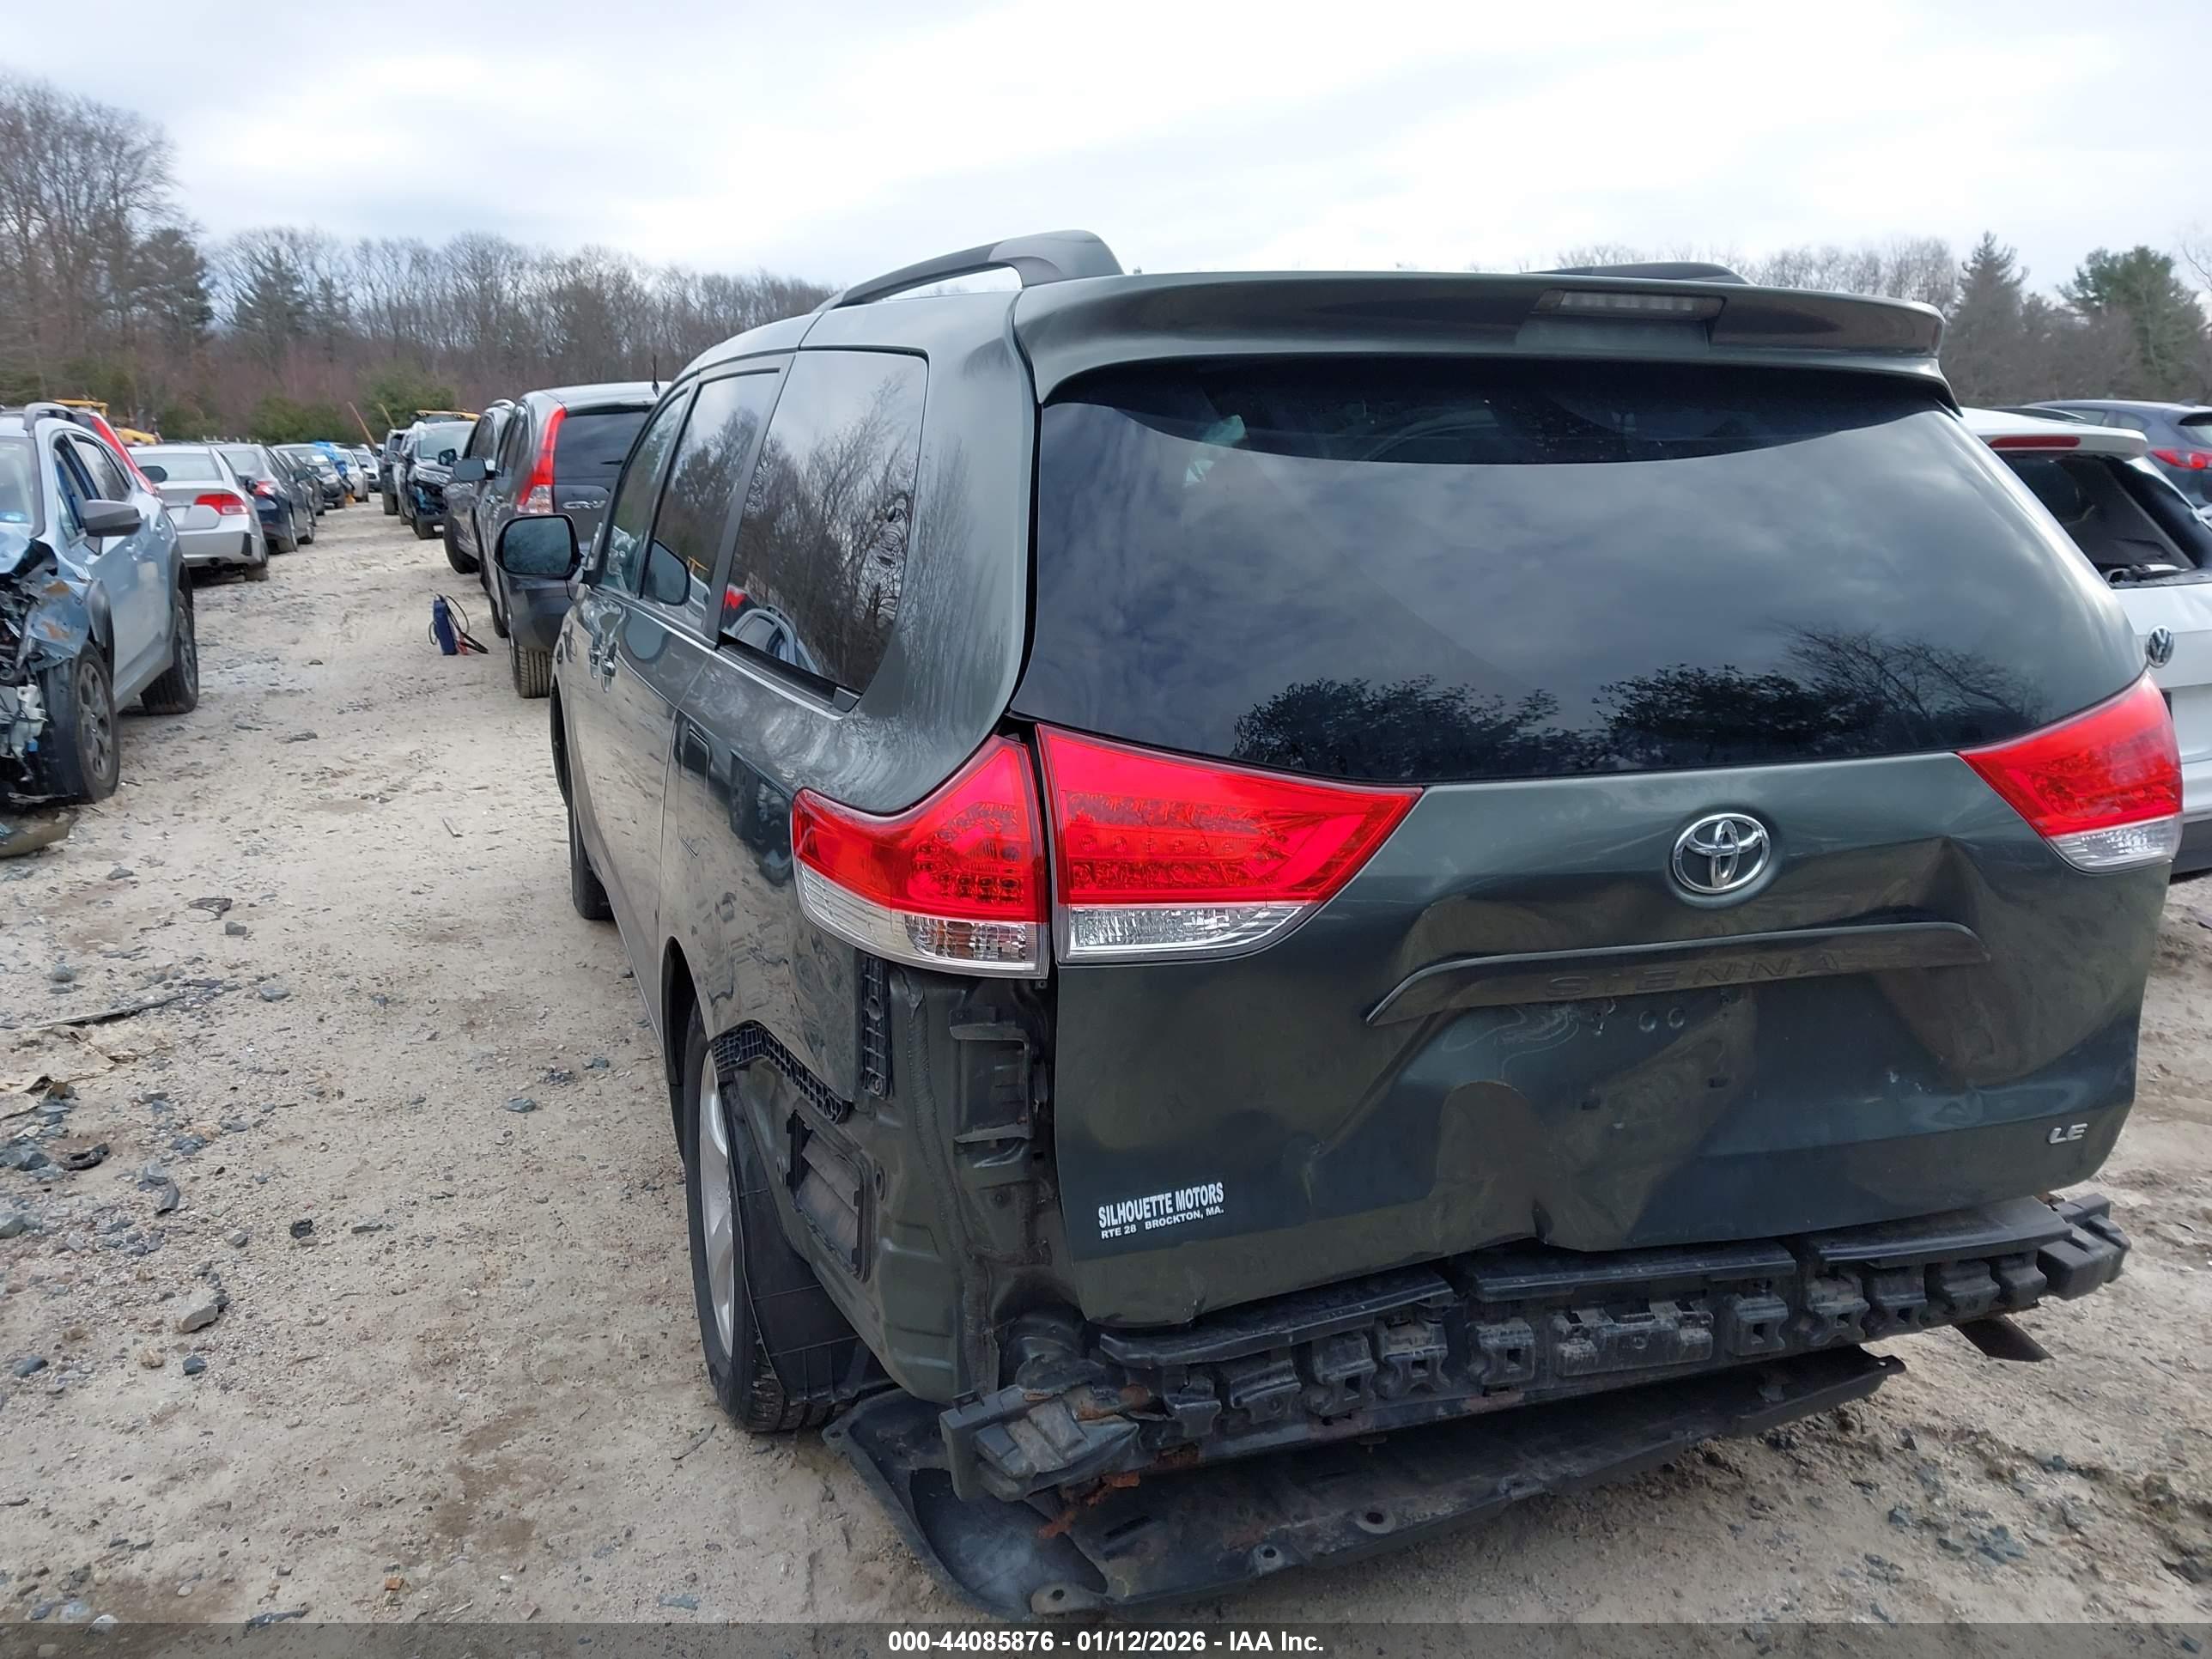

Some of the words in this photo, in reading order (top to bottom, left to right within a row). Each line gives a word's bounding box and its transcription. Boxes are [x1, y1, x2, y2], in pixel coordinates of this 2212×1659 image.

[1545, 952, 1839, 998] SIENNA
[2049, 1122, 2088, 1145] LE
[1098, 1192, 1174, 1228] SILHOUETTE
[1176, 1182, 1224, 1212] MOTORS
[1101, 1227, 1121, 1239] RTE
[1123, 1224, 1137, 1235] 28
[1145, 1210, 1203, 1230] BROCKTON,
[1206, 1206, 1224, 1217] MA.
